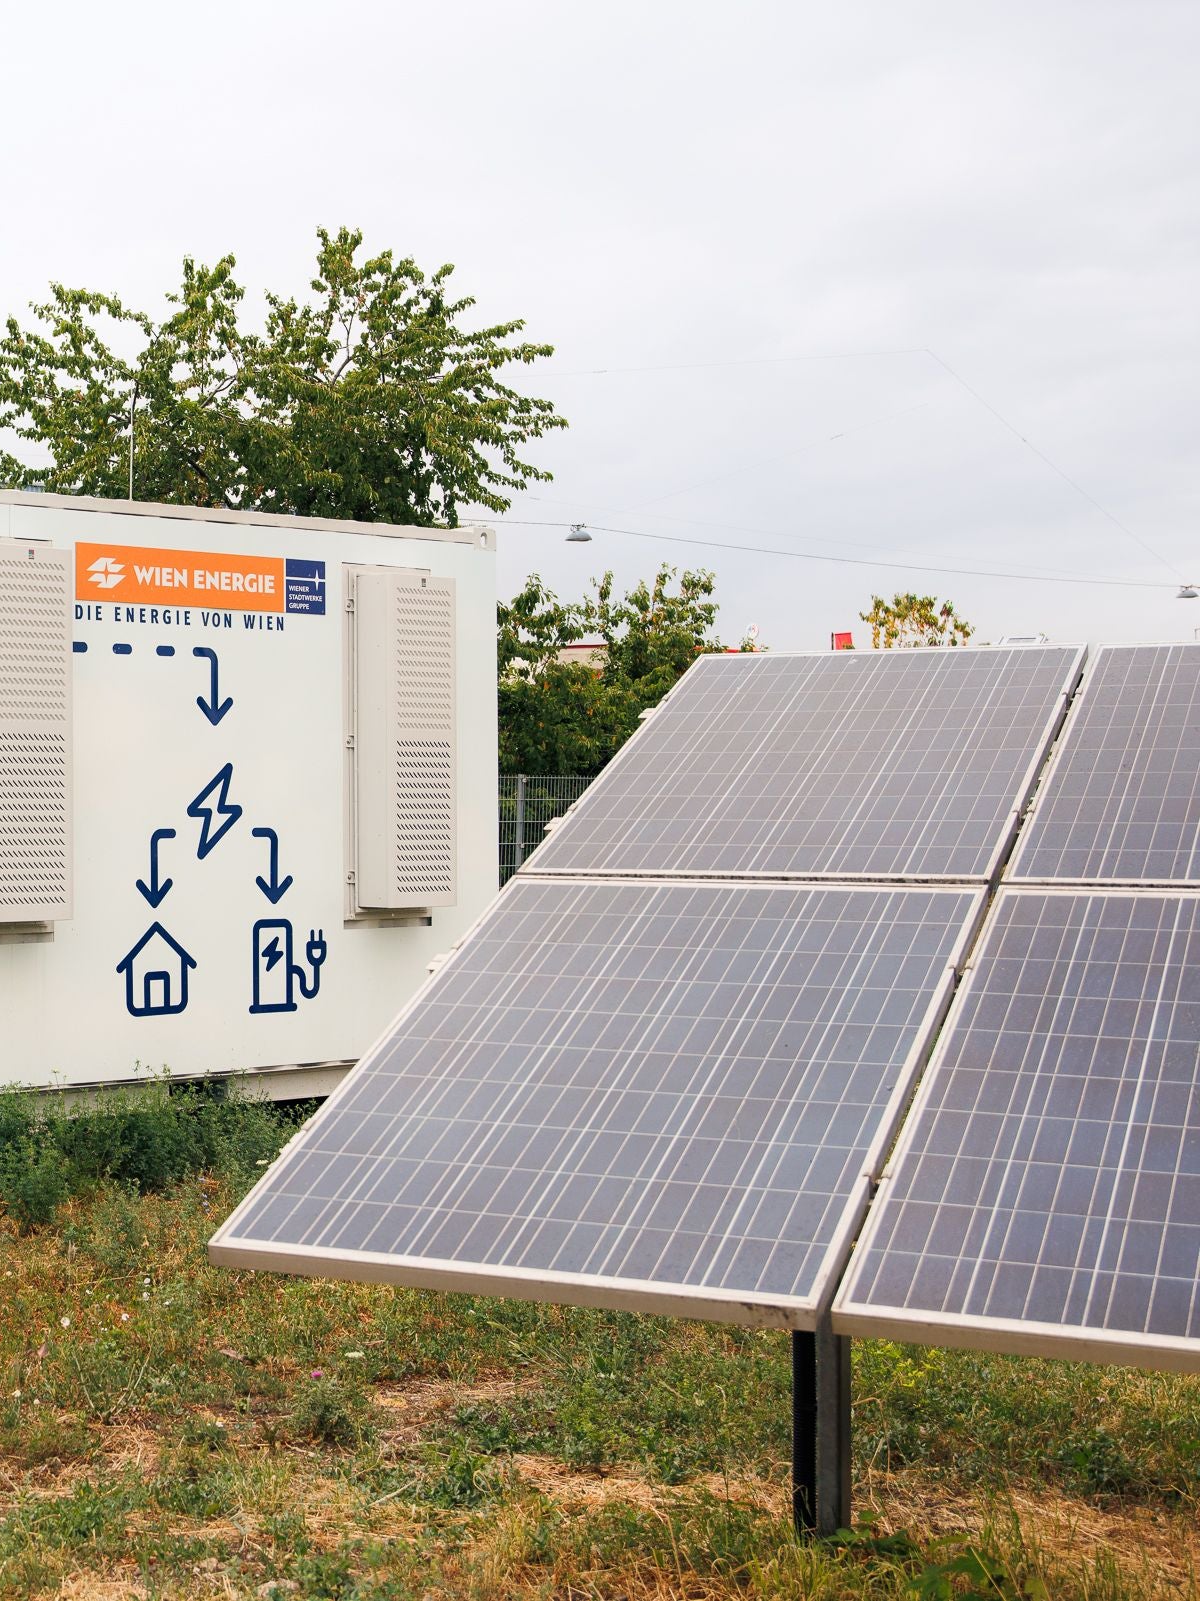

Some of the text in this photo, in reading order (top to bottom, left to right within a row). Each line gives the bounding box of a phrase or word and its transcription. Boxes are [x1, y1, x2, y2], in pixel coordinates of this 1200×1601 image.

[133, 565, 275, 594] WIEN ENERGIE
[288, 594, 323, 602] STADTWERKE
[288, 602, 310, 610] GRUPPE
[74, 604, 285, 631] DIE ENERGIE VON WIEN
